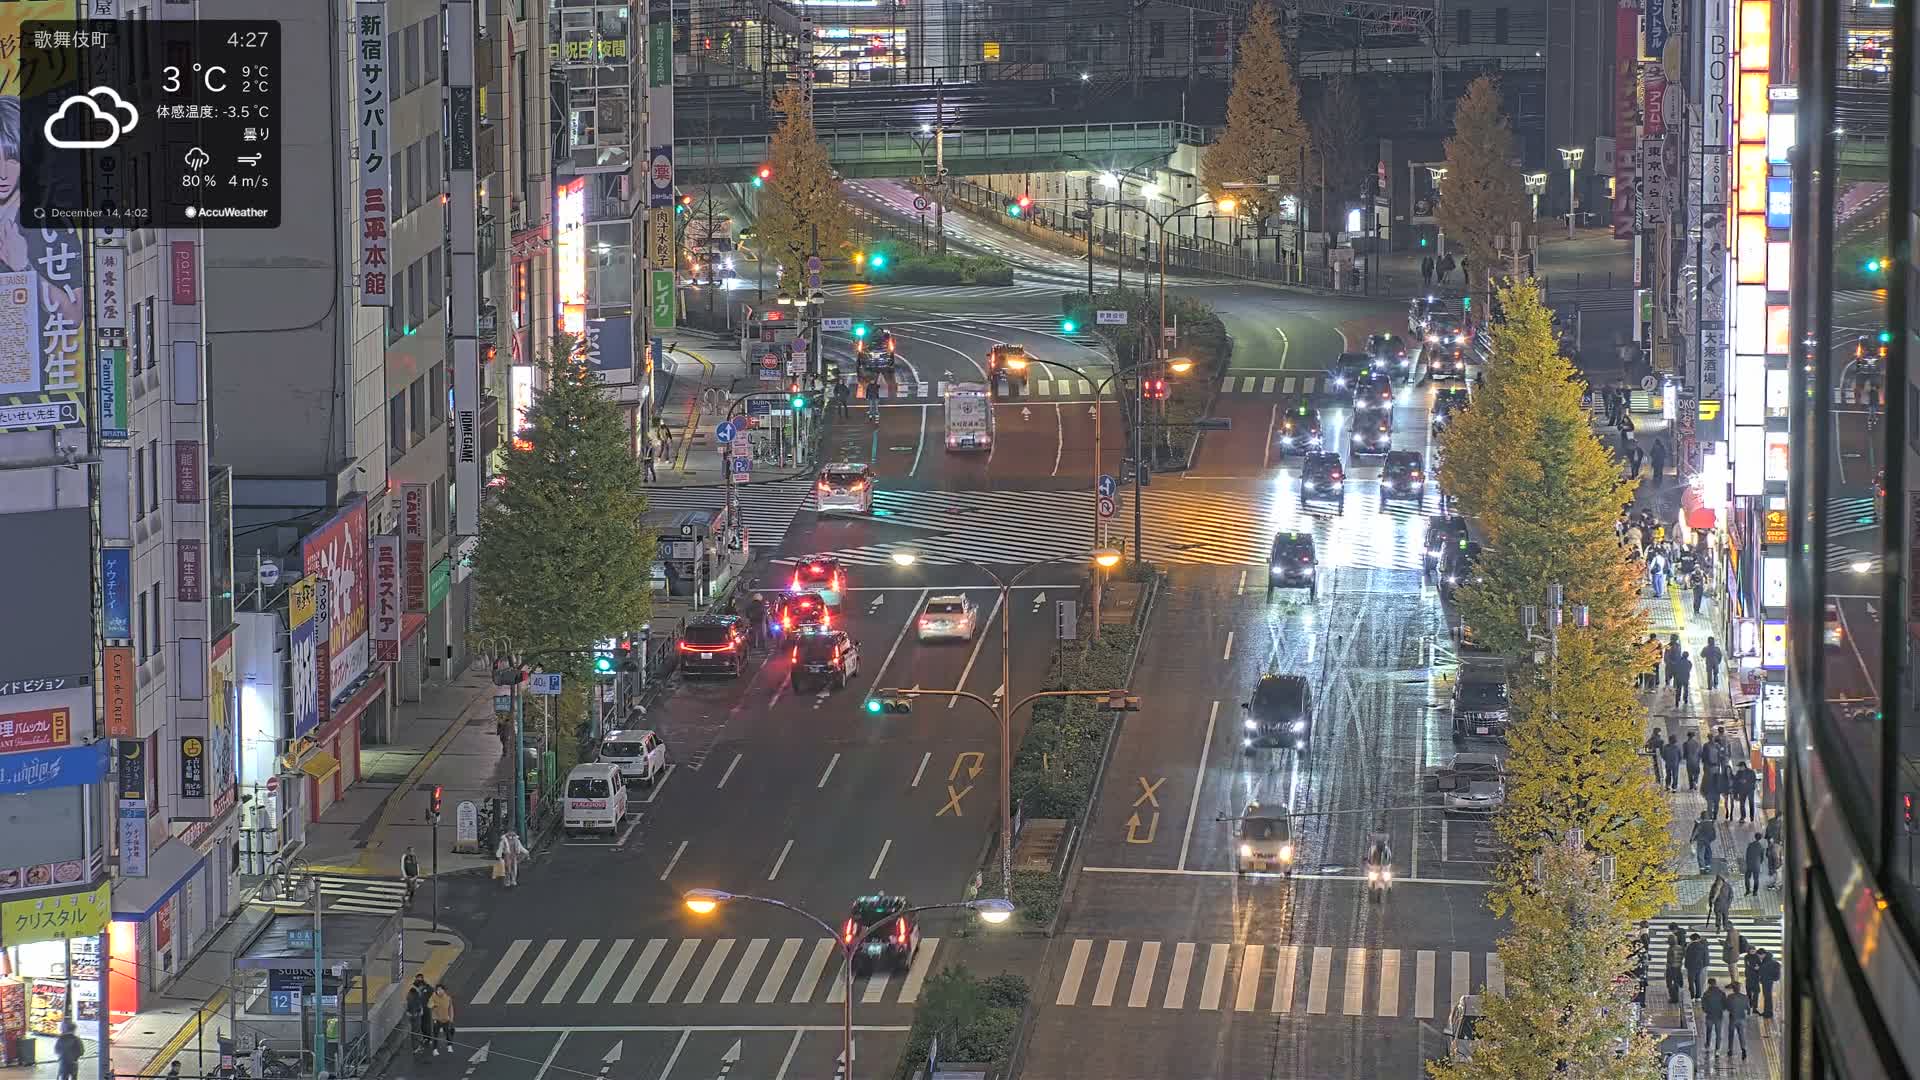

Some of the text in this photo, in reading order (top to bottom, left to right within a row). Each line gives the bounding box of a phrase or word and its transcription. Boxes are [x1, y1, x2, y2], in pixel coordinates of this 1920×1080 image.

[1650, 90, 1662, 121] アコム
[361, 15, 387, 295] 新宿サンパーク 三平本館
[654, 164, 670, 180] 薬
[656, 210, 669, 266] 肉汁水餃子
[655, 278, 669, 317] レイク
[1703, 332, 1718, 385] 大衆酒場
[103, 357, 113, 418] FamilyMart
[461, 411, 473, 463] HOMEGAME
[406, 491, 417, 534] GAME
[319, 584, 327, 623] 389
[378, 546, 396, 633] 三平ストア
[113, 654, 123, 681] CAFE
[114, 697, 123, 723] CRIE
[116, 686, 124, 696] de
[15, 908, 88, 930] クリスタル
[272, 995, 288, 1008] 12
